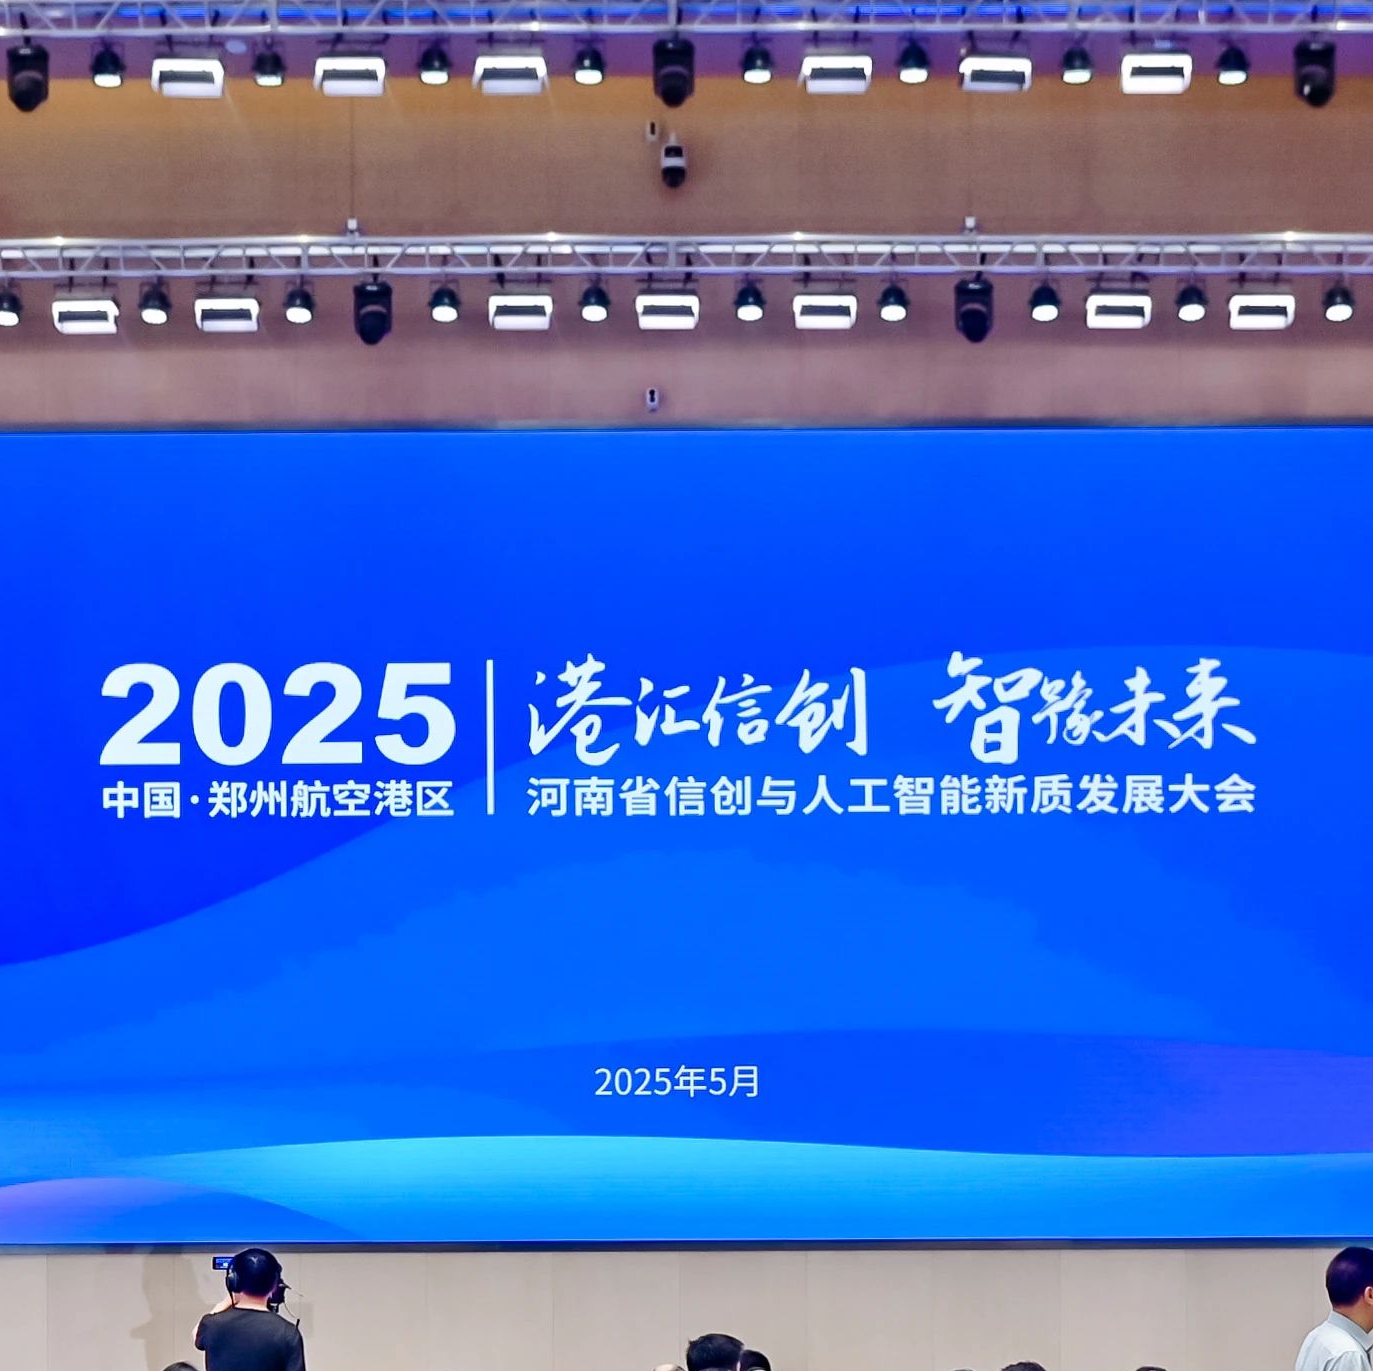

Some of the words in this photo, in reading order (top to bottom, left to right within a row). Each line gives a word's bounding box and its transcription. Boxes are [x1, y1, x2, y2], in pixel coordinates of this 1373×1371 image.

[100, 662, 456, 765] 2025
[529, 654, 867, 765] 港汇信创
[933, 651, 1256, 764] 智豫未来
[103, 780, 454, 818] 中国·郑州航空港区
[527, 773, 1255, 816] 河南省信创与人工智能新质发展大会
[596, 1065, 758, 1097] 2025年5月
